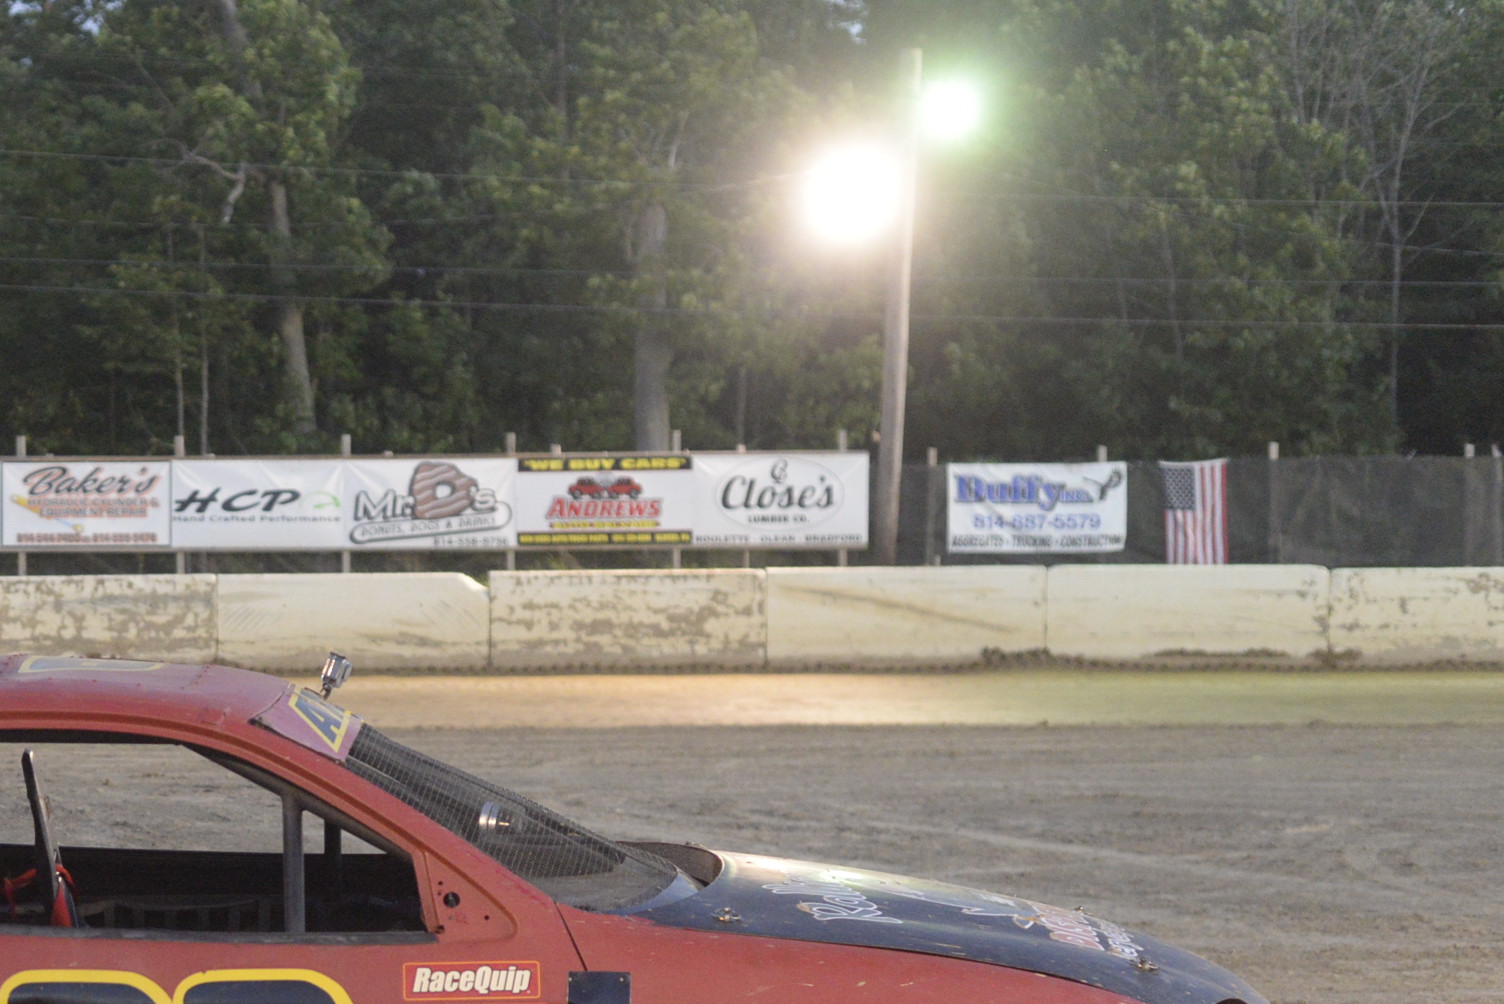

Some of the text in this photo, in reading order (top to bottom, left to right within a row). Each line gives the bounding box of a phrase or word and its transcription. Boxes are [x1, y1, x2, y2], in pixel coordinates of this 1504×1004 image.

[568, 459, 616, 470] BUY
[22, 465, 161, 497] Baker's
[721, 474, 834, 510] Close's
[174, 486, 302, 513] HCP
[545, 496, 663, 519] ANDREWS
[748, 514, 789, 523] LUMBER
[412, 965, 531, 994] RaceQuip
